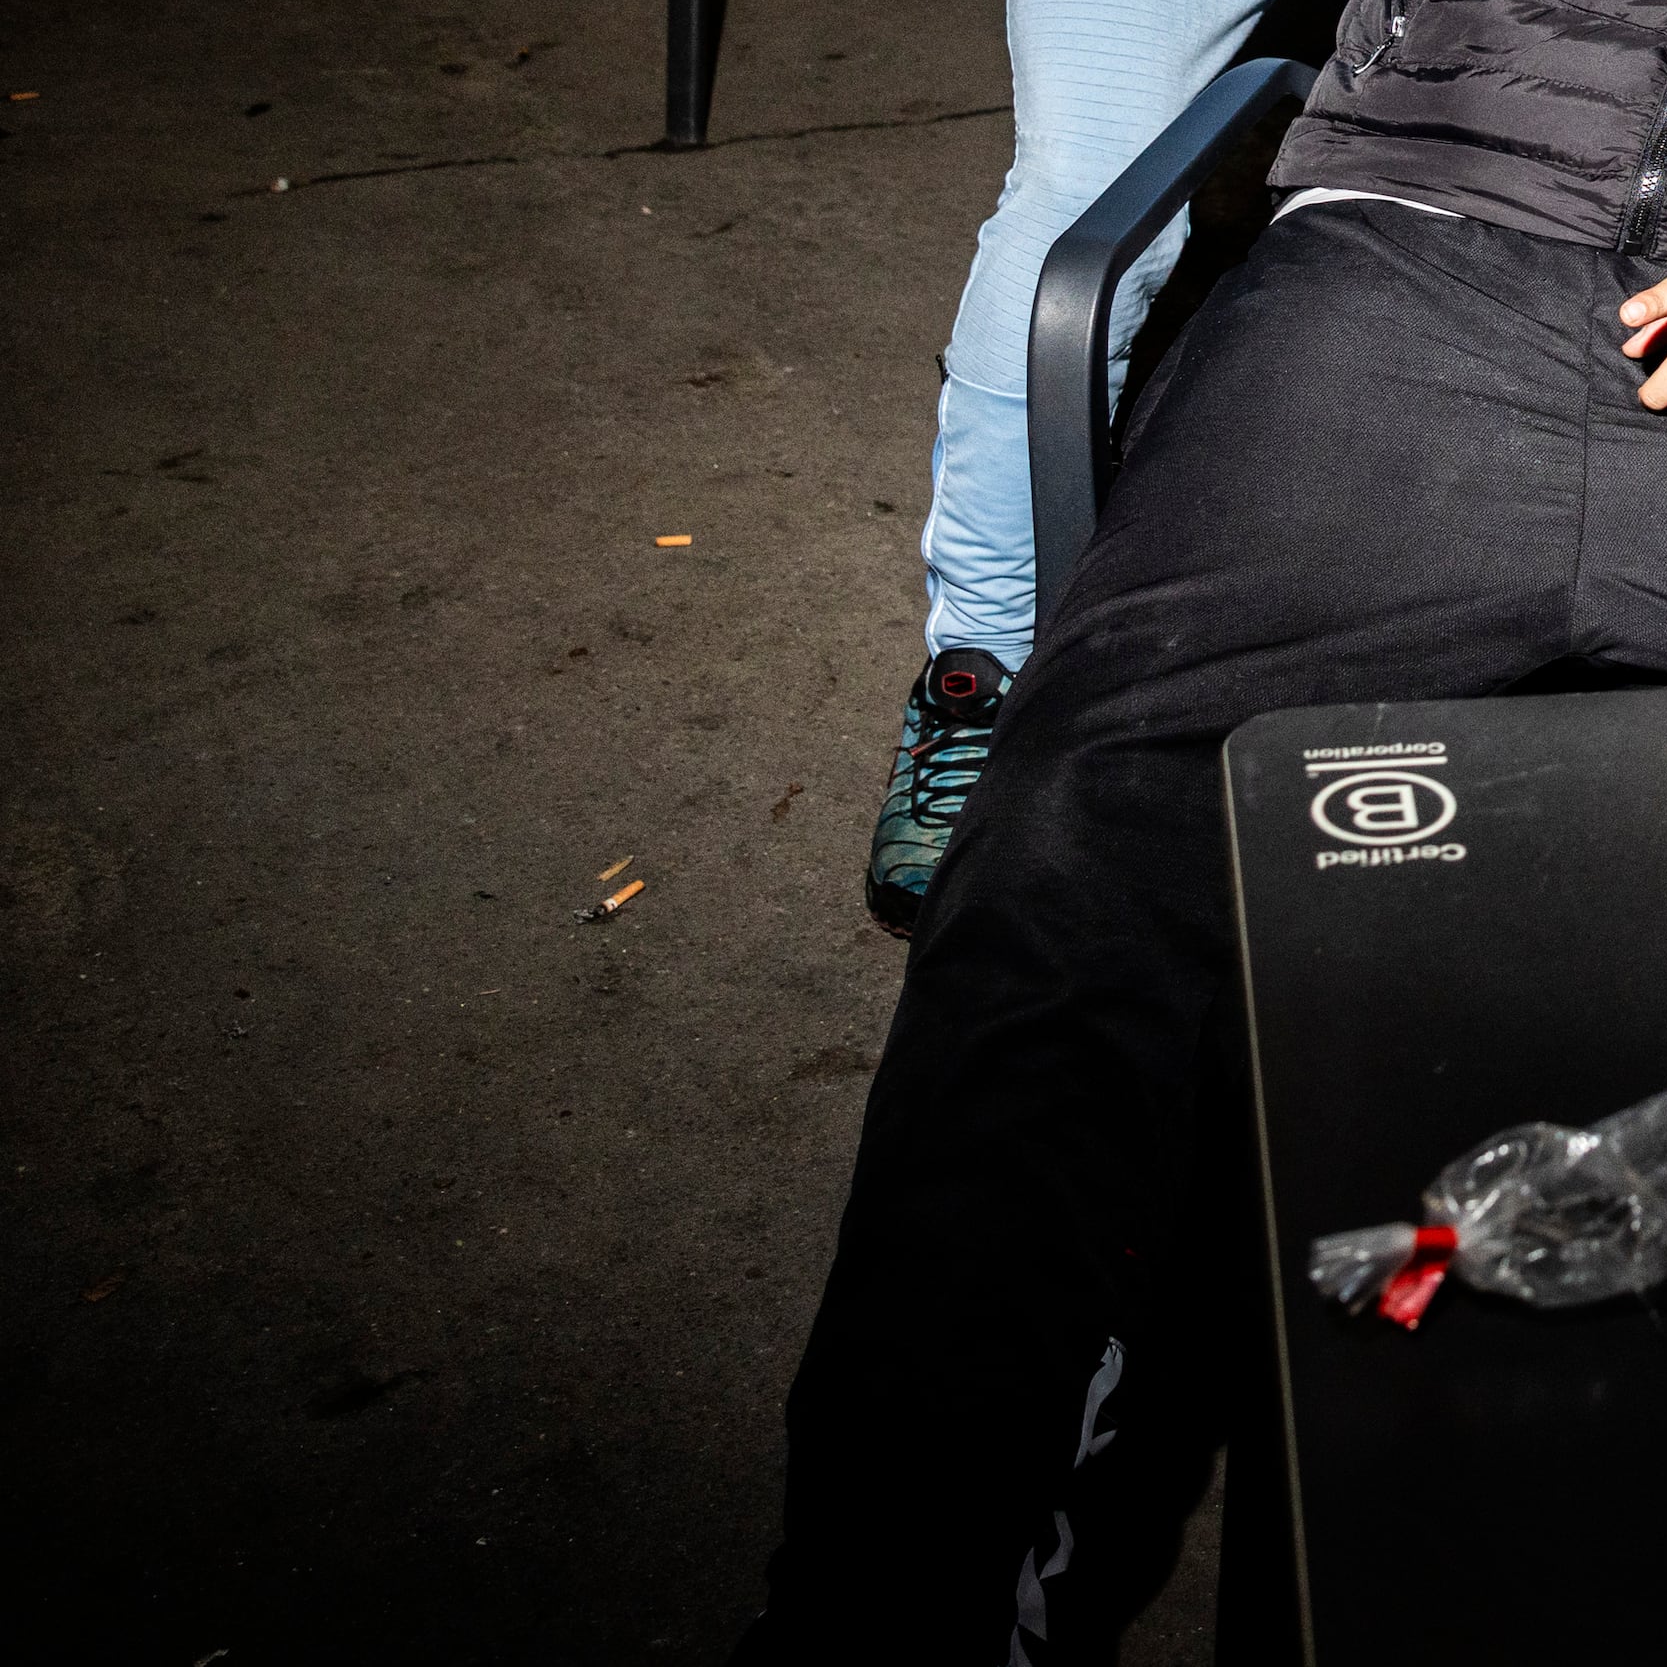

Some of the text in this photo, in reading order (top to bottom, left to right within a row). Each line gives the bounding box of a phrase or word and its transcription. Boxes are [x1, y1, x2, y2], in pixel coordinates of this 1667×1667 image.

[1303, 741, 1447, 760] Corporation
[1346, 784, 1419, 831] B
[1315, 843, 1468, 870] Certified
